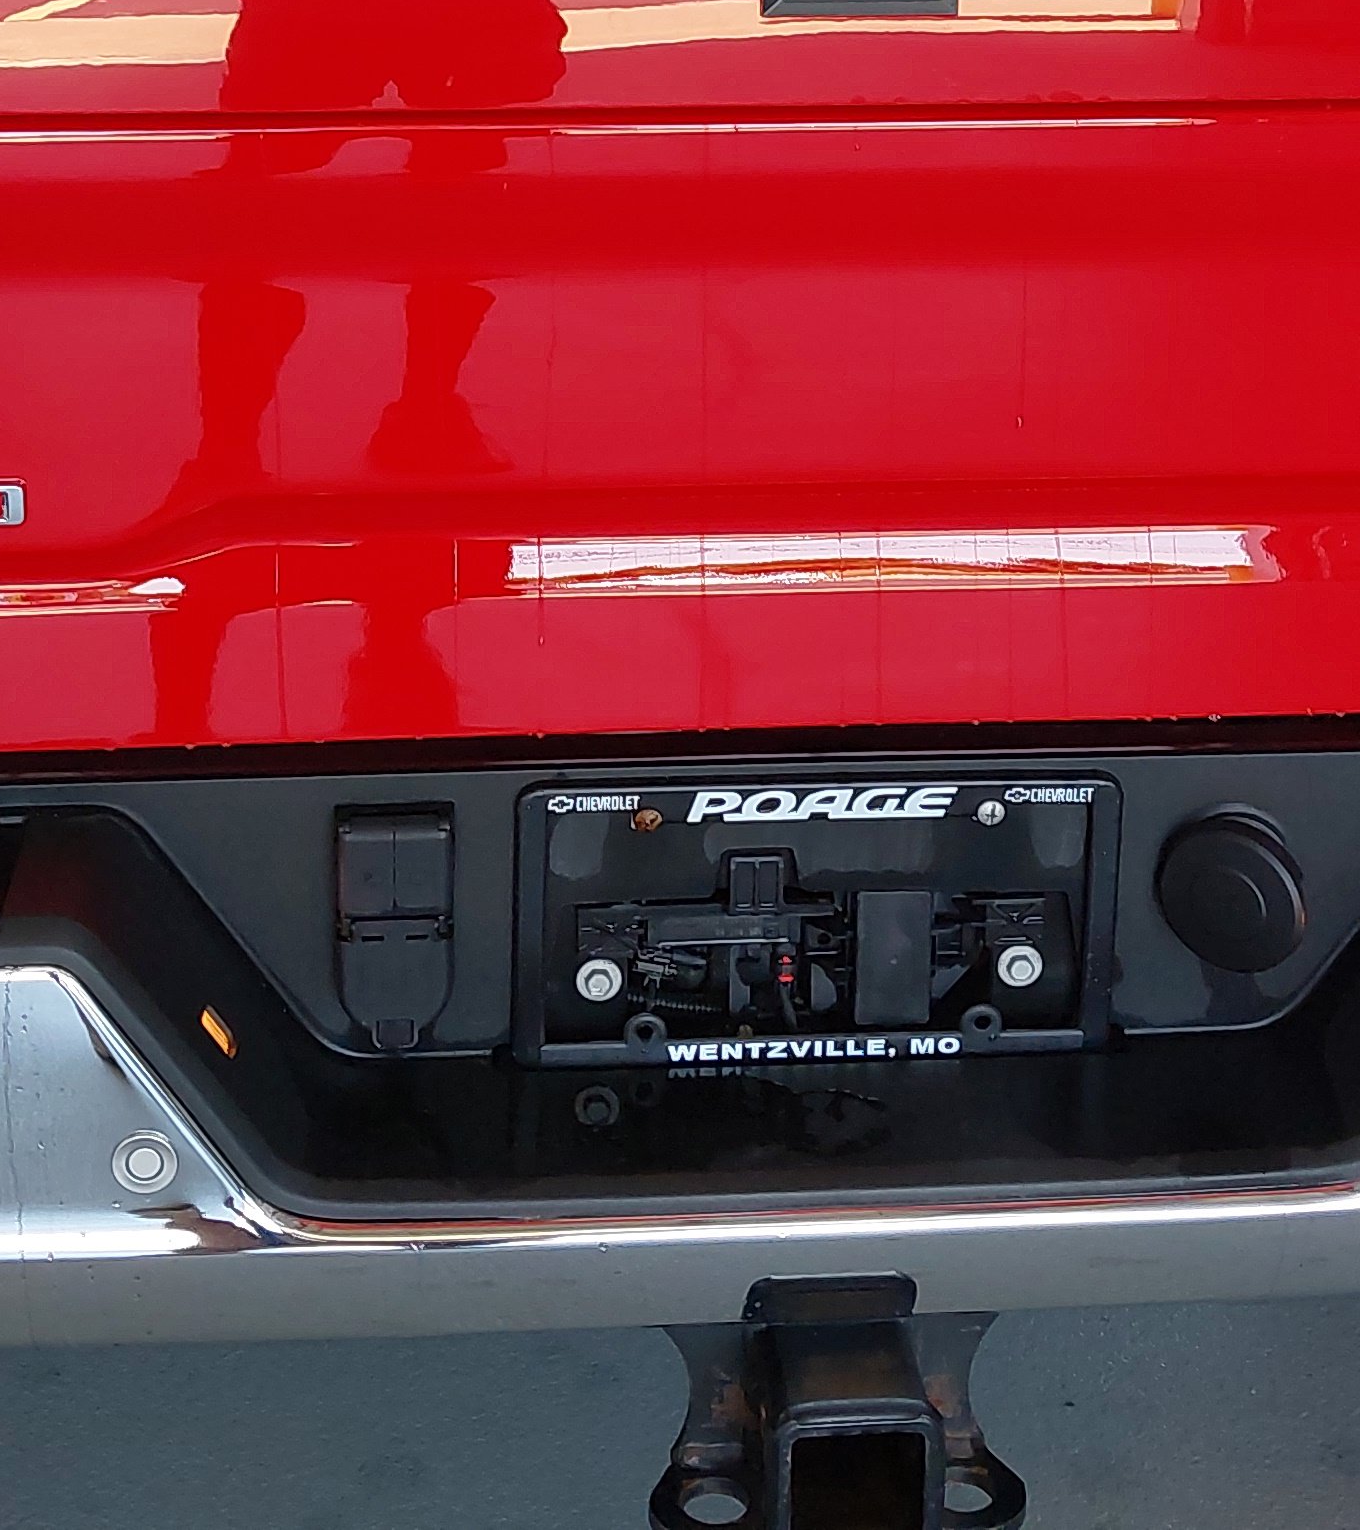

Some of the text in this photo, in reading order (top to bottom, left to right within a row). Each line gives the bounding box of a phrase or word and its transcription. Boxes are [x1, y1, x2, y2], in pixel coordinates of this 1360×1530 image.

[575, 795, 640, 812] CHEVROLET
[686, 786, 959, 823] POAGE
[1031, 787, 1094, 803] CHEVROLET
[667, 1036, 961, 1062] WENTZVILLE, MO
